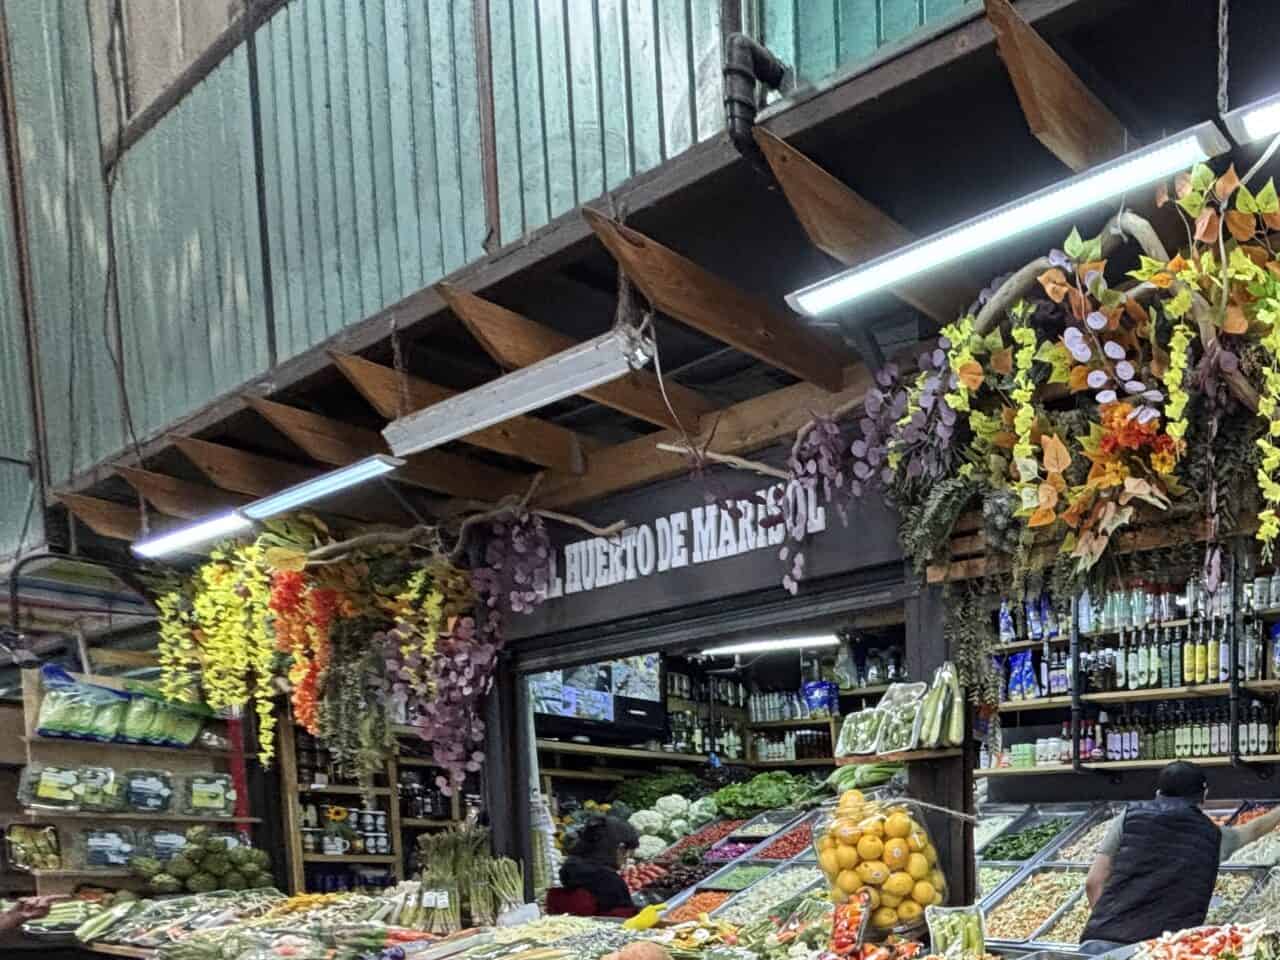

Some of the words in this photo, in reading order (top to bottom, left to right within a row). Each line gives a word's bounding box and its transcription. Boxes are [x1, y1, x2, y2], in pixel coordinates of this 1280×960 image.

[564, 524, 655, 594] HUERTO
[655, 511, 688, 573] DE
[691, 480, 825, 563] MARISOL
